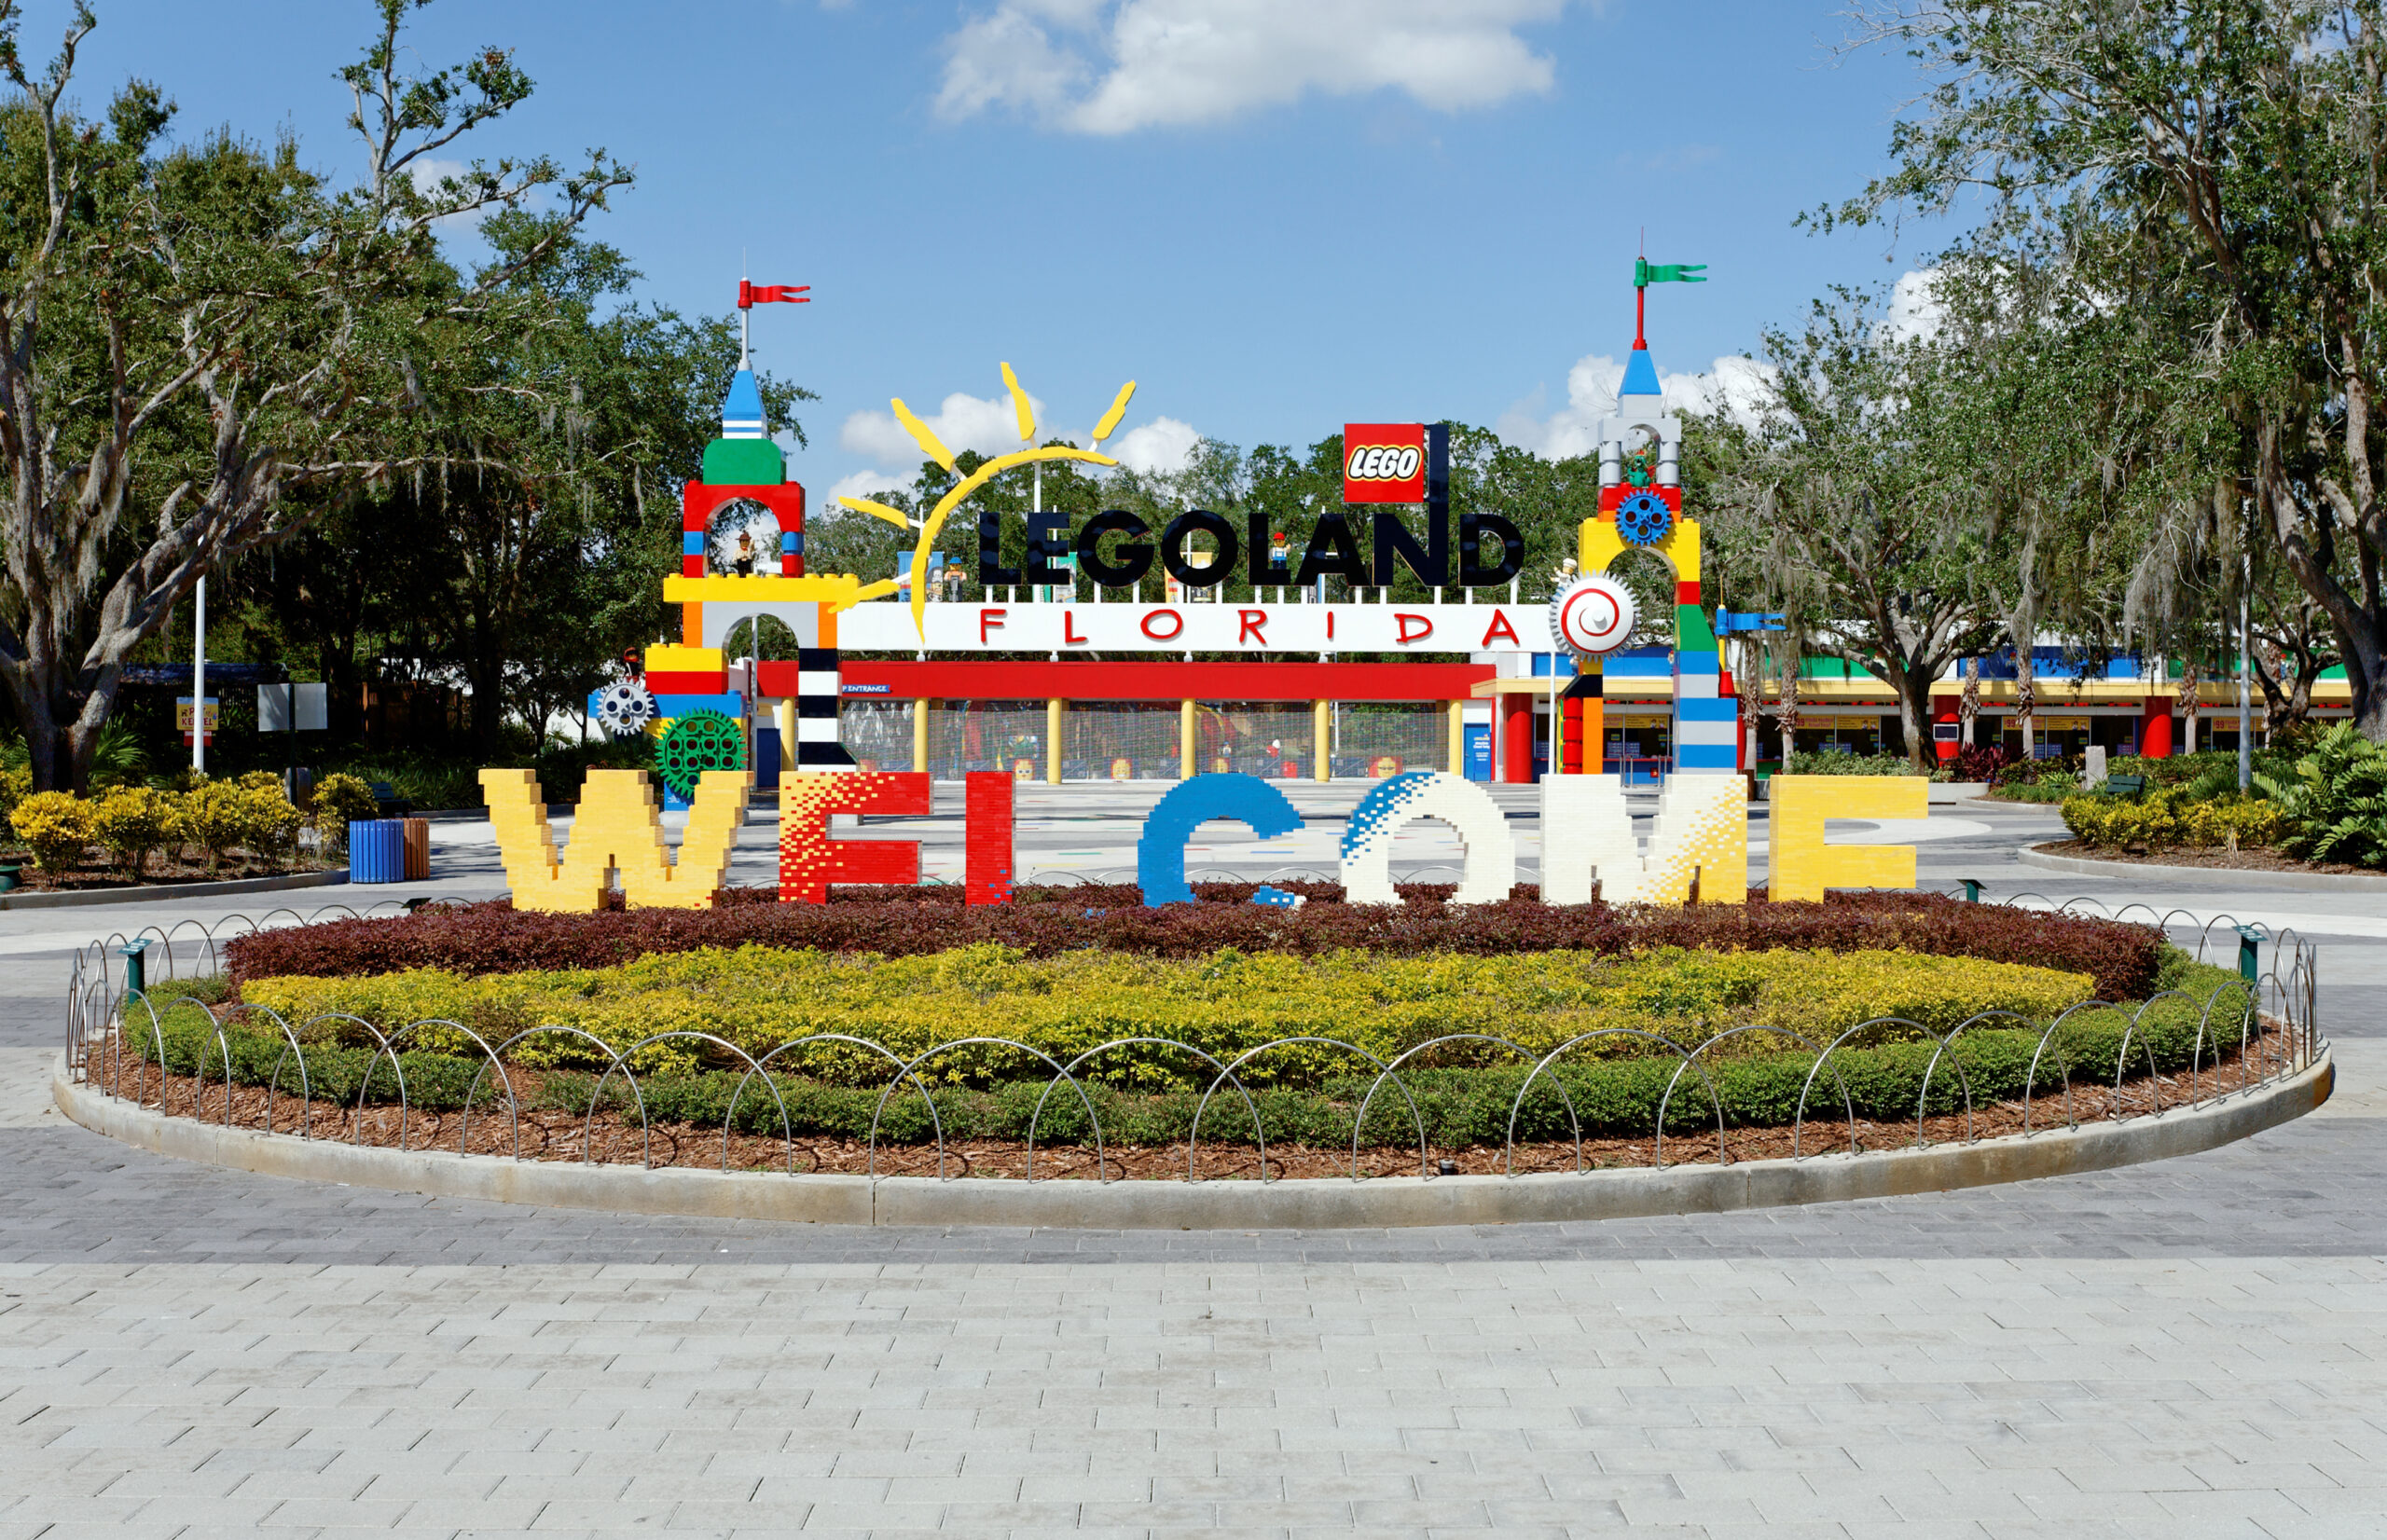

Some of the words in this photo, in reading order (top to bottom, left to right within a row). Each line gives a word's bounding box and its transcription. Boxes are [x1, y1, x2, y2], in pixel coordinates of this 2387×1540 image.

[1348, 447, 1419, 478] LEGO
[979, 509, 1525, 587] LEGOLAND
[980, 608, 1520, 647] FLORIDA
[181, 717, 213, 725] KEEL
